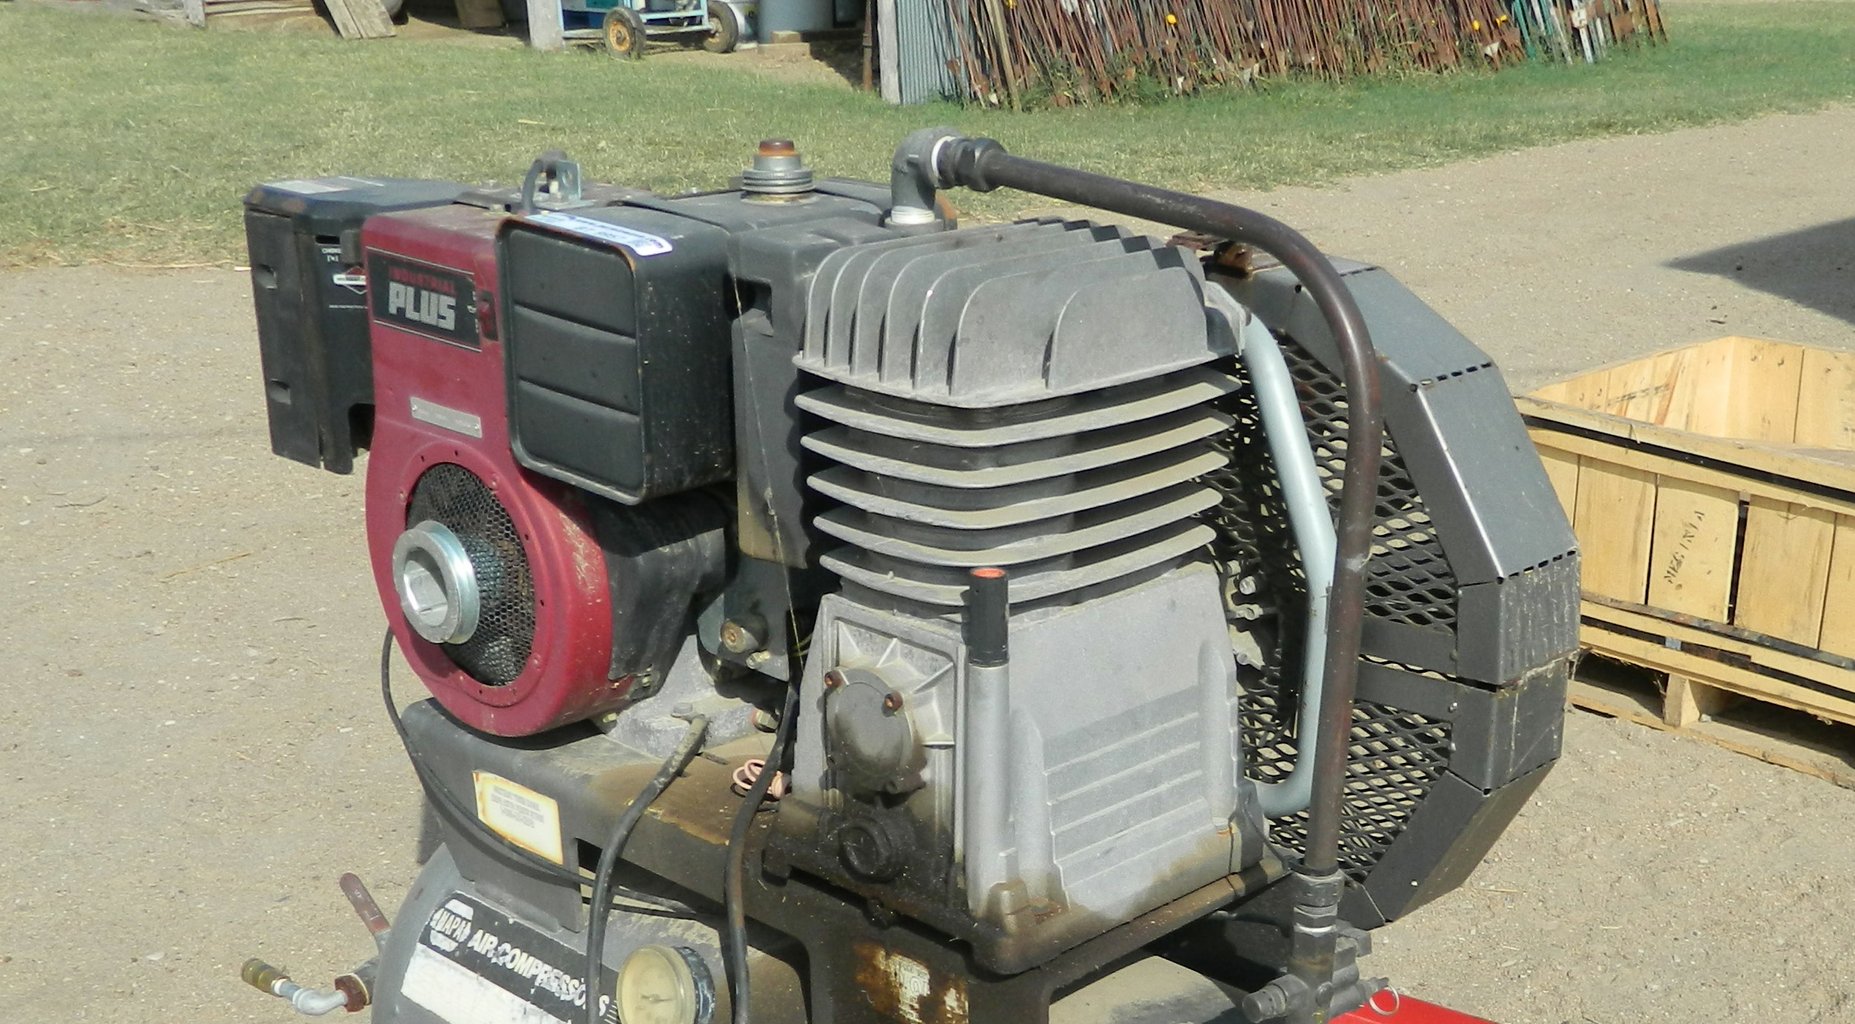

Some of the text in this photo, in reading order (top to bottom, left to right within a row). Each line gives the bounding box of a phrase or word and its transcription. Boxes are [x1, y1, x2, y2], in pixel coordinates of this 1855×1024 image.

[388, 280, 457, 331] PLUS
[438, 911, 468, 942] NAPA
[467, 929, 610, 1017] AIR COMPRESSOS
